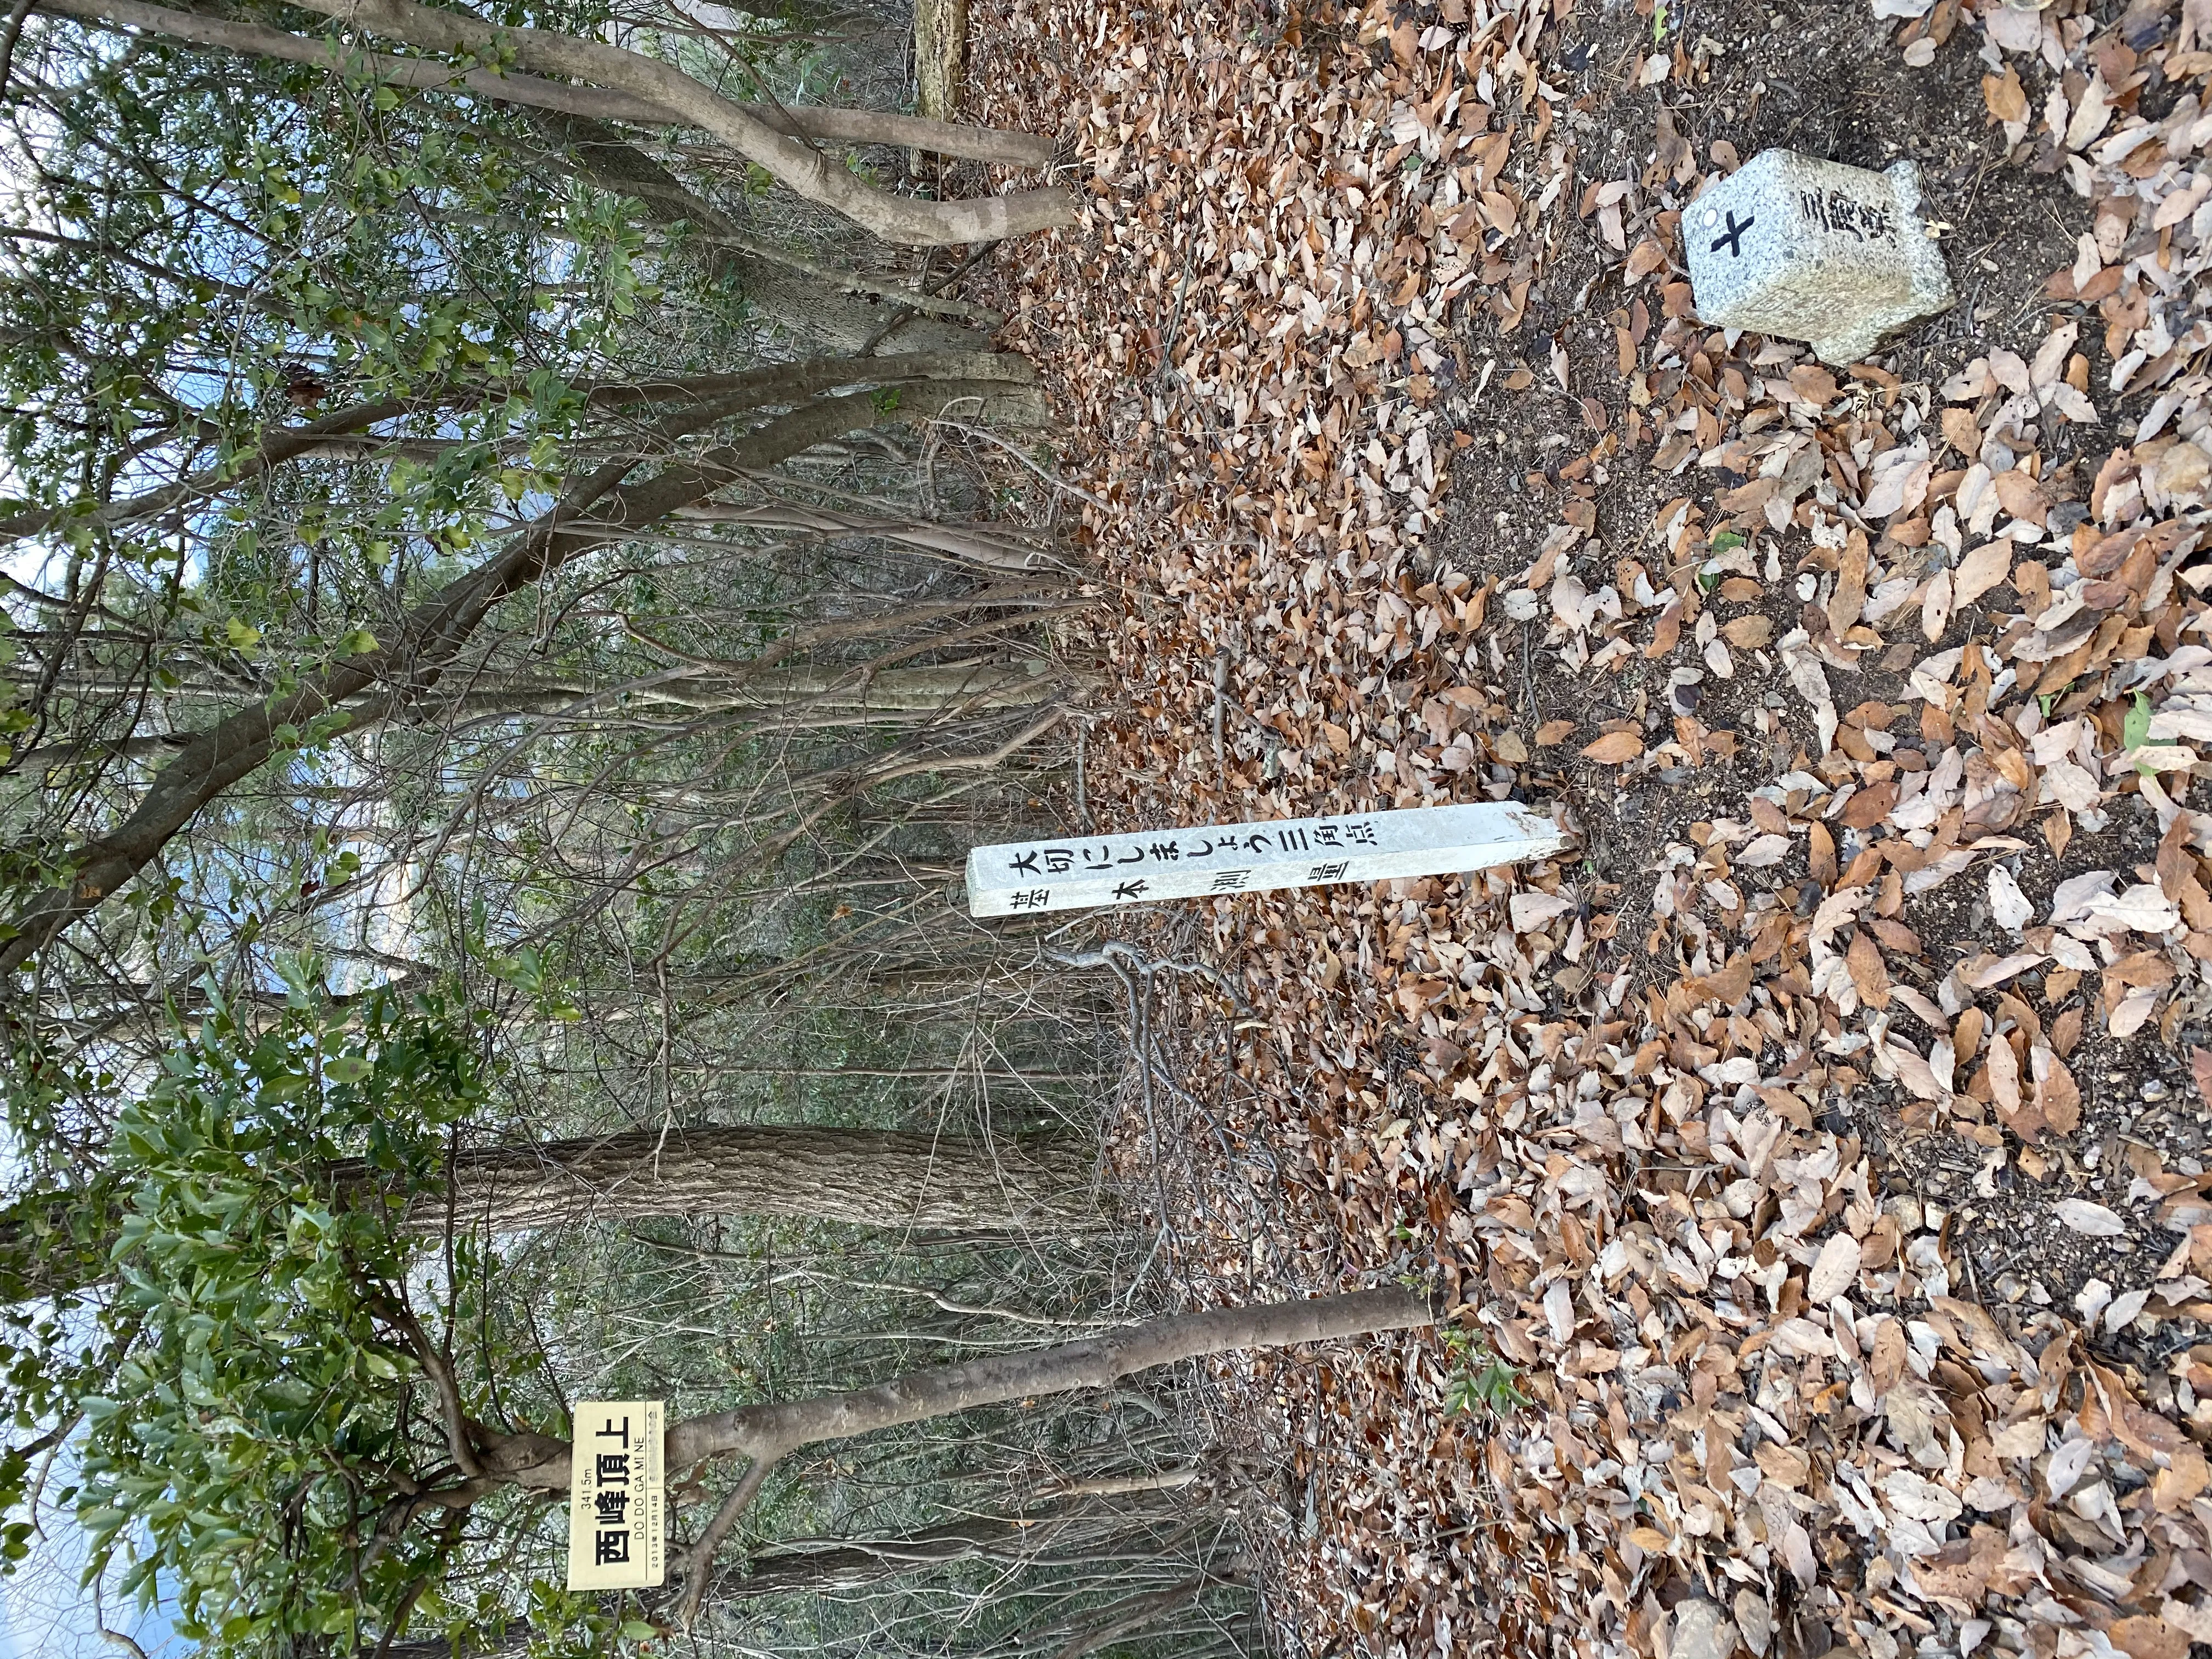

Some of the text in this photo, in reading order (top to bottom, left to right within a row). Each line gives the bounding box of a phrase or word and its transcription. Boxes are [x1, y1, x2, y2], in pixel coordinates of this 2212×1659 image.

[1008, 821, 1378, 878] 大切にしましょう三角点
[1009, 861, 1350, 909] 基本測量
[581, 1468, 592, 1510] 341.5m
[594, 1416, 630, 1566] 西峰頂上
[634, 1436, 645, 1540] DO DO GA MI NE
